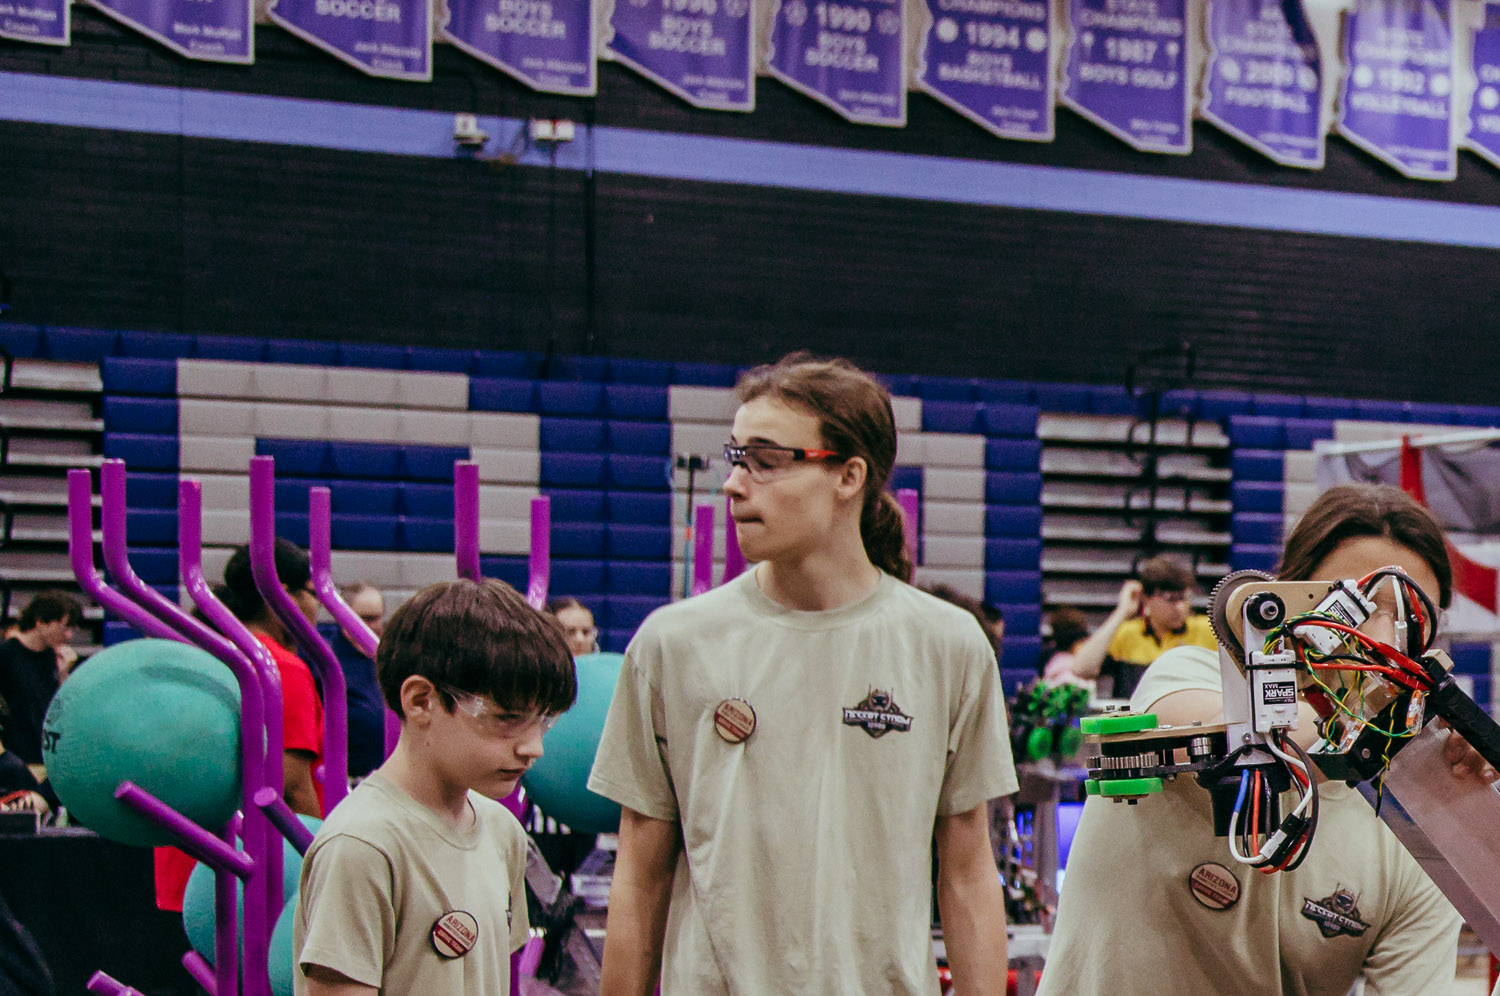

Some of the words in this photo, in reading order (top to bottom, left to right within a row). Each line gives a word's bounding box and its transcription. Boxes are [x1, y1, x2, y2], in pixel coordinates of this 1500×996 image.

[484, 13, 566, 39] SOCCER
[661, 15, 713, 38] BOYS
[1080, 8, 1182, 35] CHAMPIONS
[649, 31, 726, 55] SOCCER
[965, 21, 1020, 49] 1994
[805, 49, 879, 72] SOCCER
[938, 62, 1042, 90] BASKETBALL
[1264, 688, 1295, 698] SPARK
[1198, 867, 1237, 895] ARIZONA
